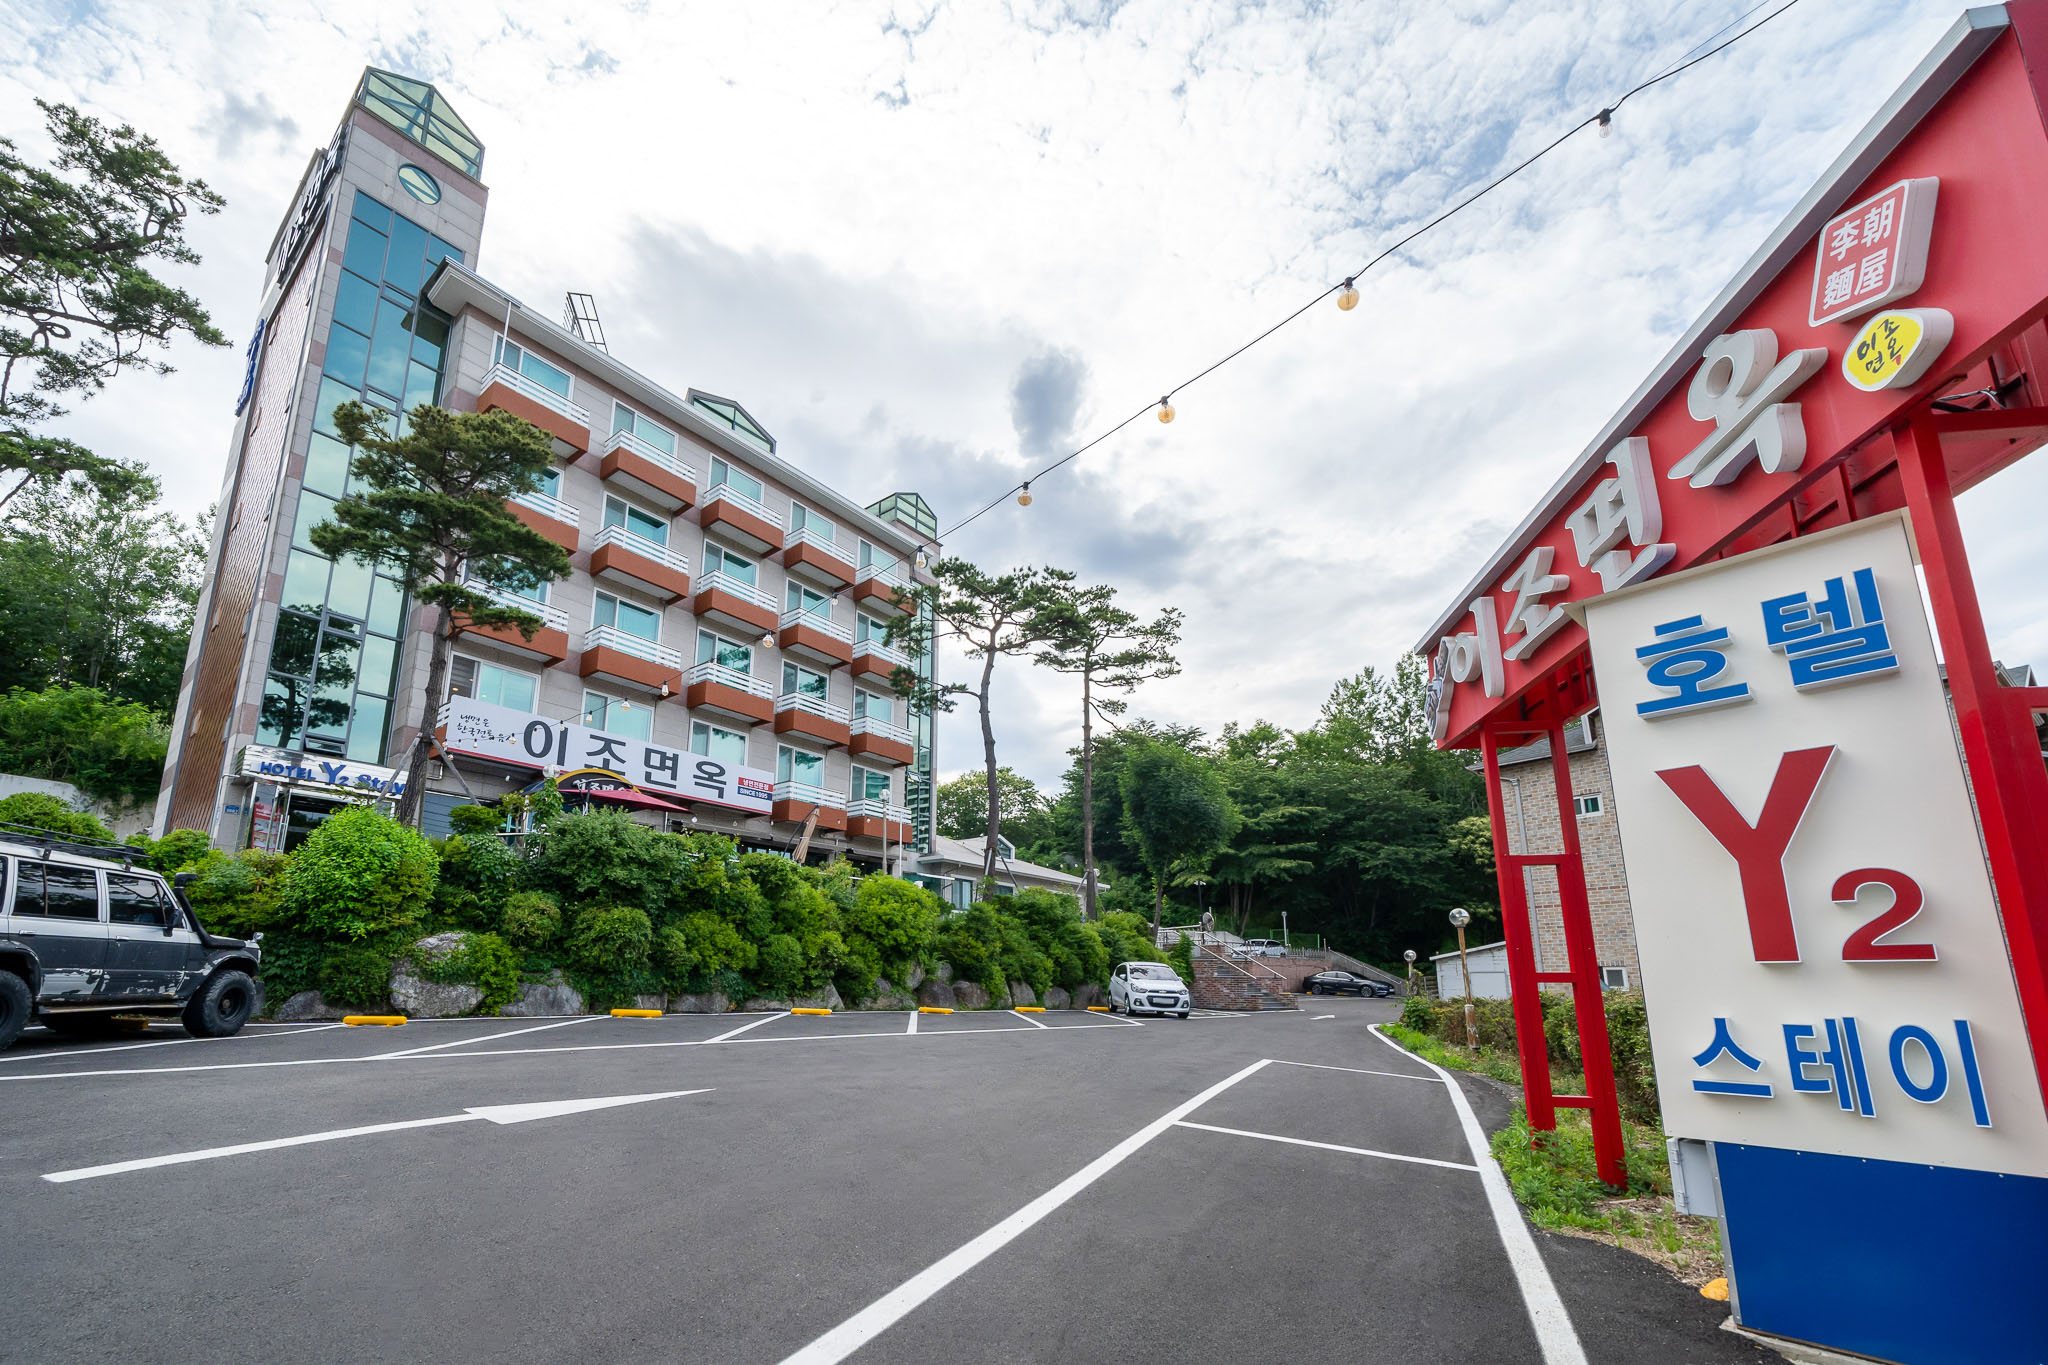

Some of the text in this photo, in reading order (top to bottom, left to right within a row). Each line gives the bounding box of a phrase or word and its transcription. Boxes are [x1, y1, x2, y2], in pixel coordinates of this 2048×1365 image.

[1829, 197, 1896, 262] 李朝
[1450, 328, 1829, 698] 이조면옥
[1635, 566, 1900, 719] 호텔
[259, 760, 317, 783] HOTEL
[321, 761, 350, 786] Y2
[523, 719, 728, 800] 이조면옥
[739, 788, 769, 799] SINCE 1995
[1654, 743, 1939, 963] Y2
[1691, 1016, 1993, 1129] 스테이
